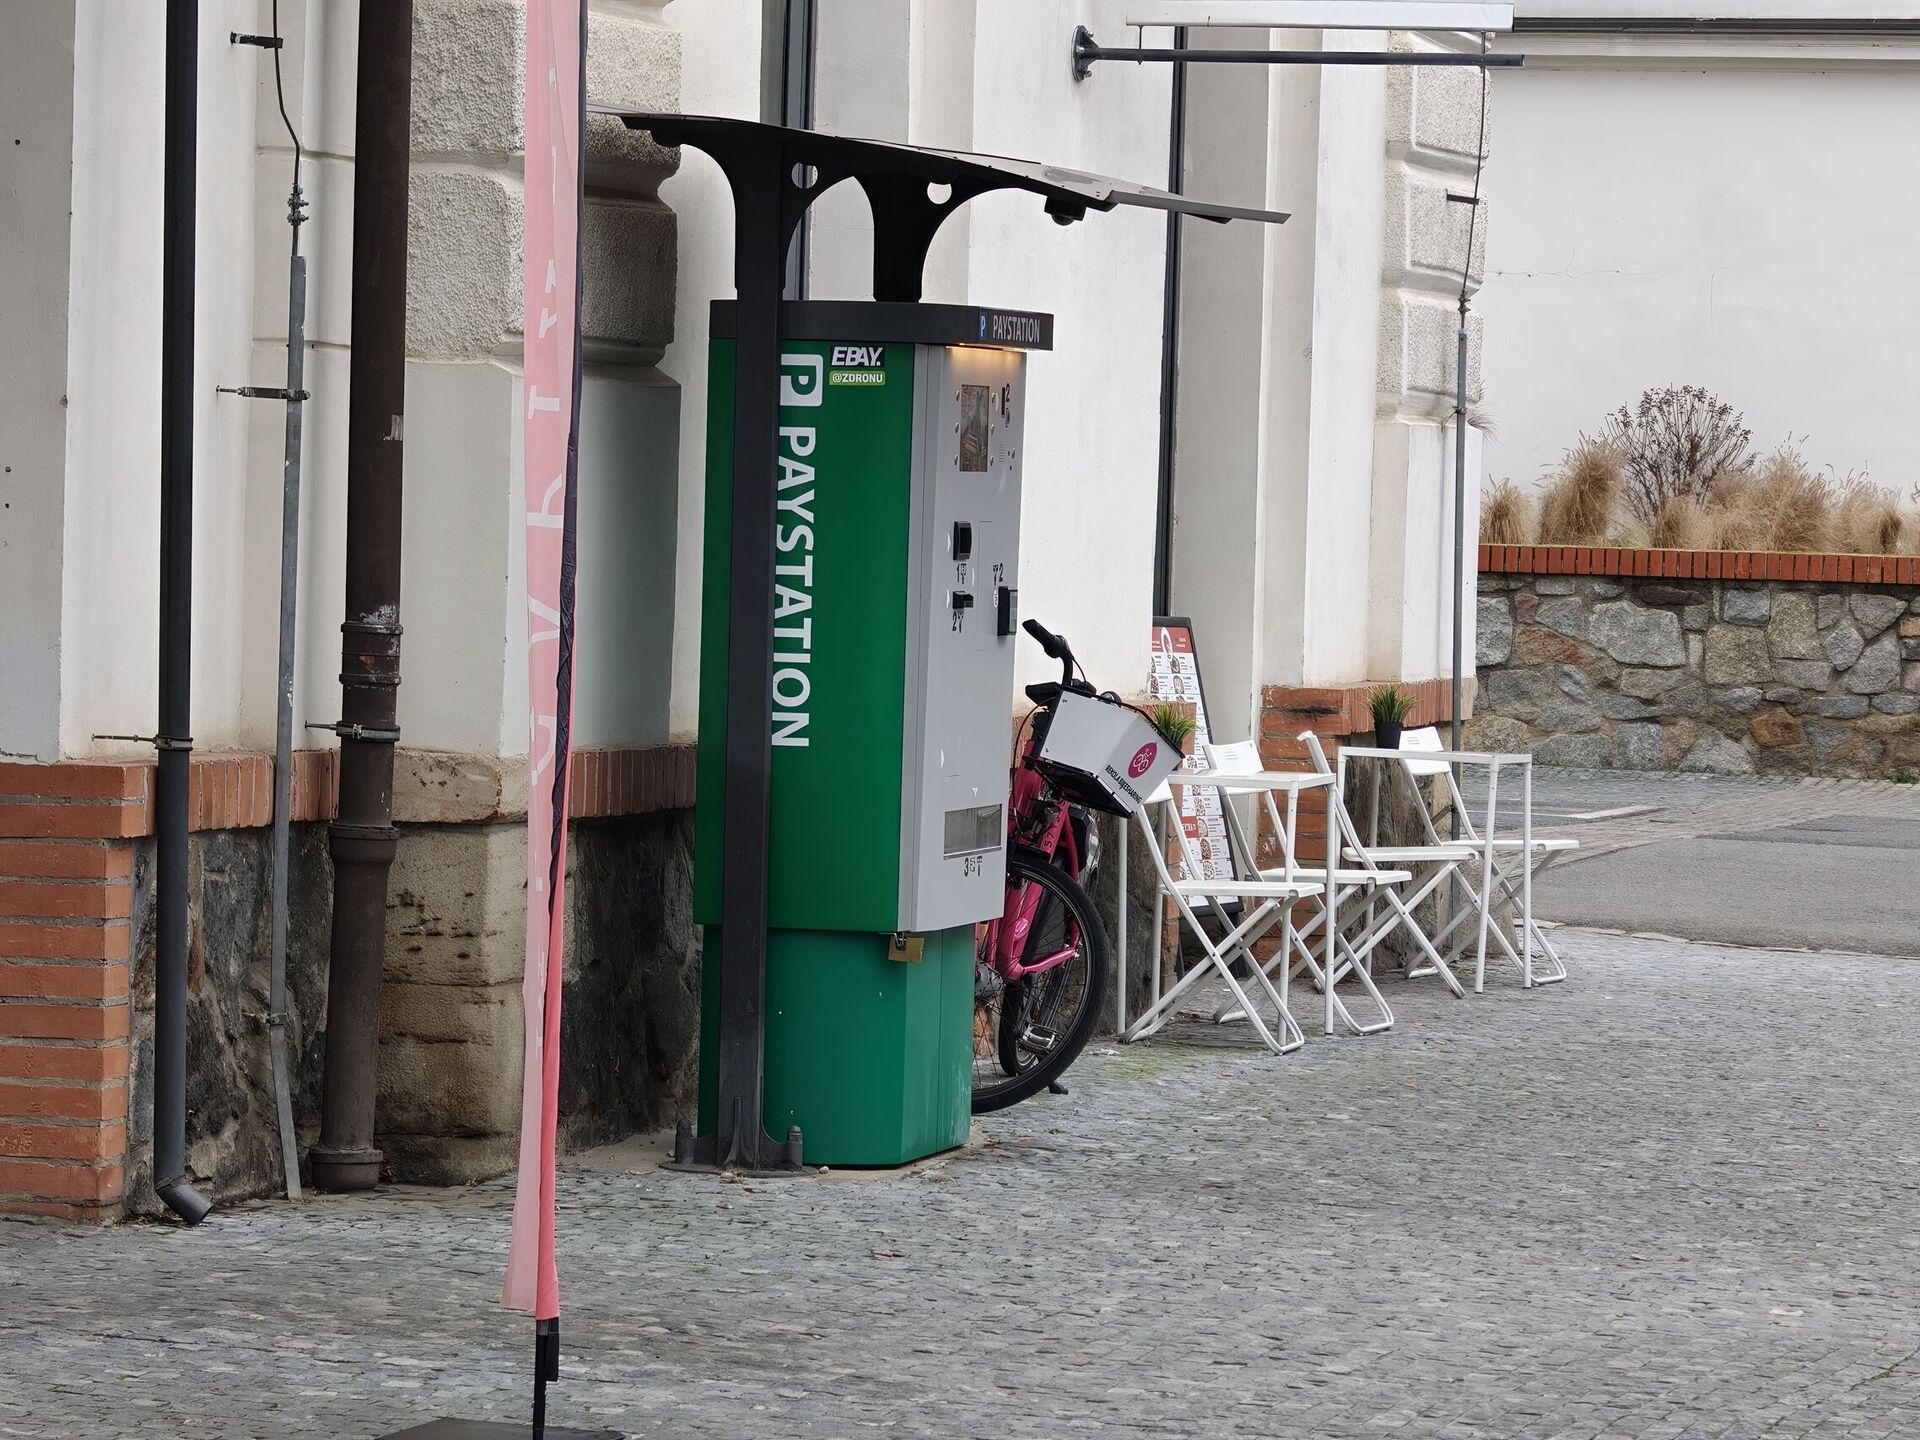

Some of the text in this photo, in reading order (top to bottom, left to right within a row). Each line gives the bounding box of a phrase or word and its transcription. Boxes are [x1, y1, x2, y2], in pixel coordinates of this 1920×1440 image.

[992, 314, 1041, 343] PAYSTATION
[832, 372, 883, 383] @ZDRONU
[771, 426, 816, 747] PAYSTATION
